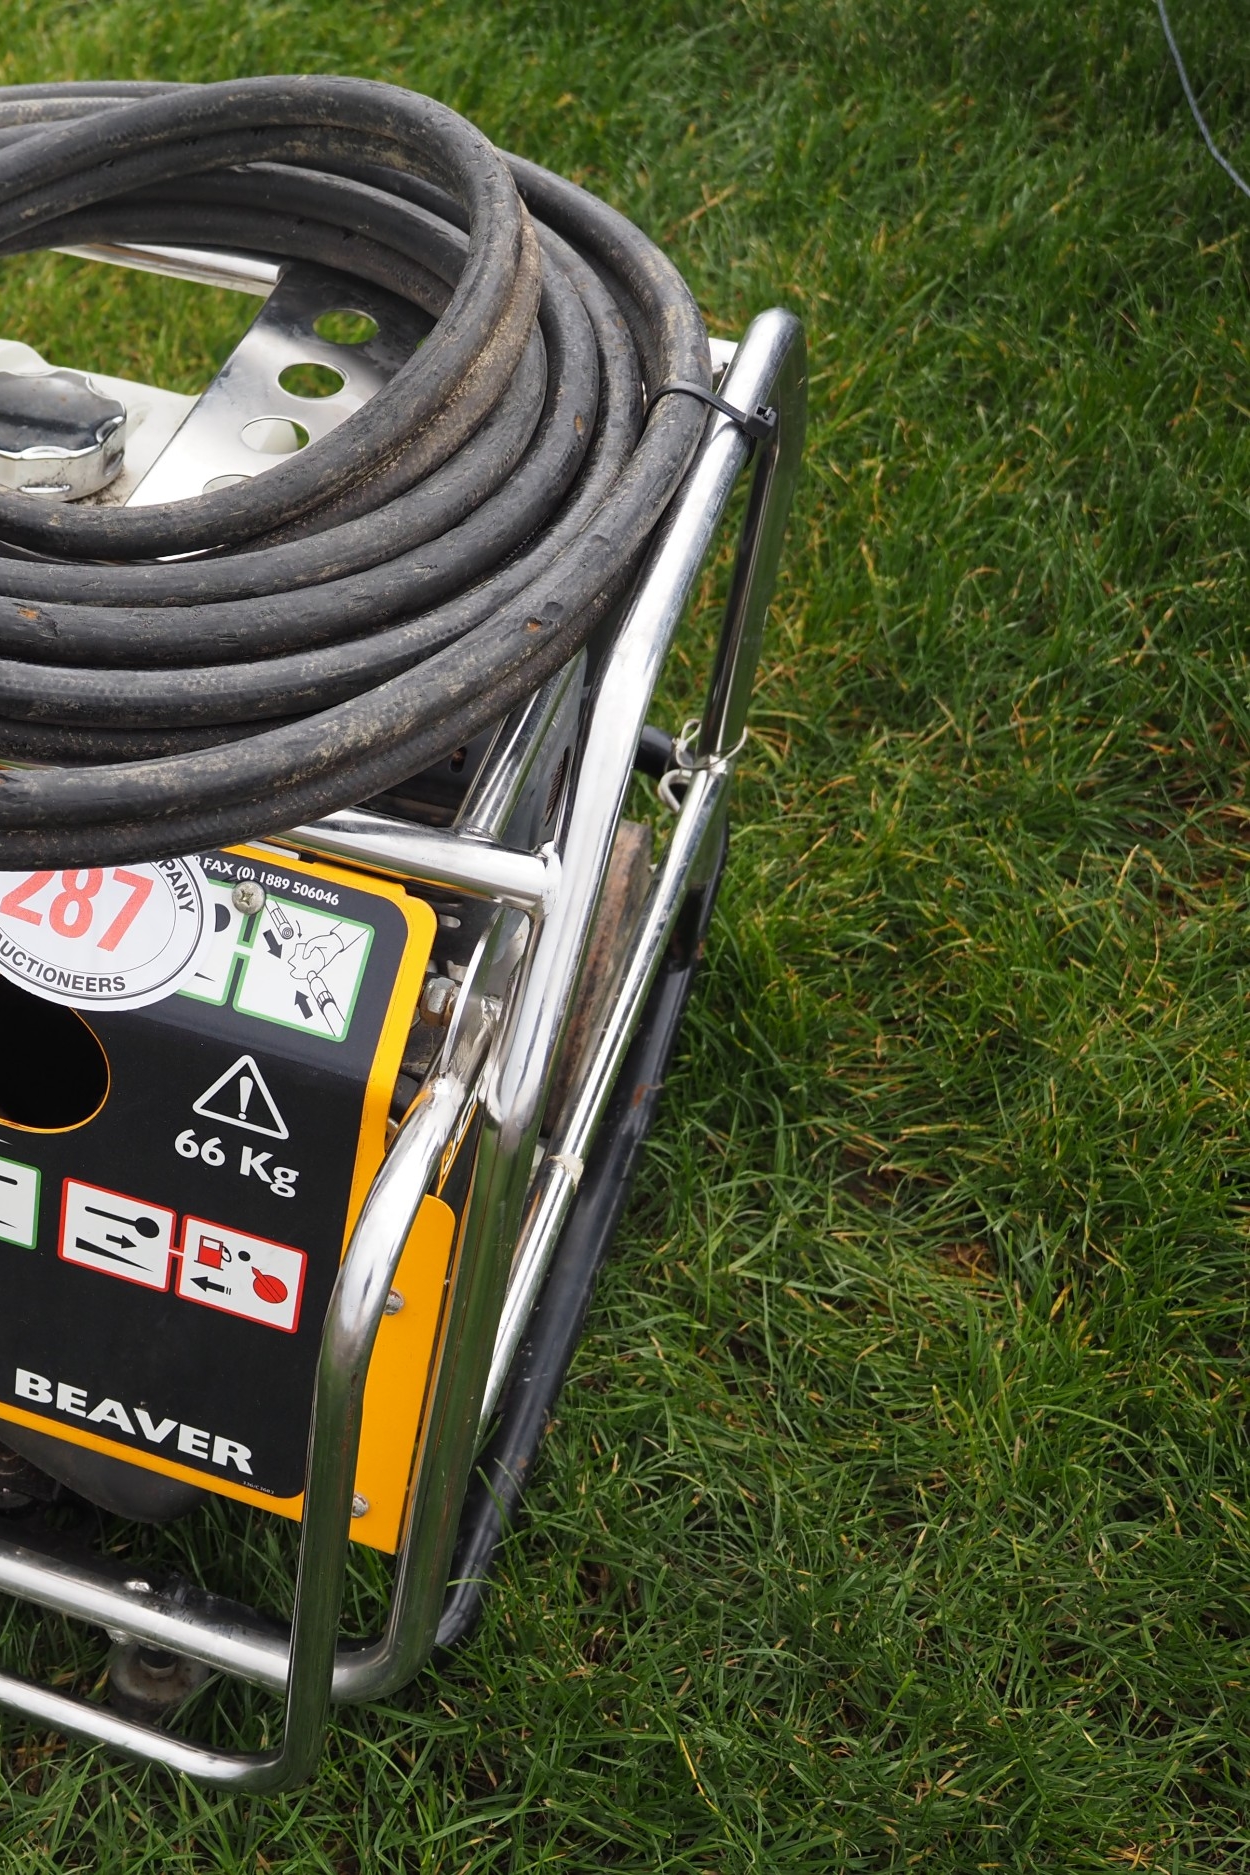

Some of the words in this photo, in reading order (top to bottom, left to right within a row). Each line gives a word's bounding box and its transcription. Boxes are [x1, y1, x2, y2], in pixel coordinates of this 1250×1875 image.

[153, 857, 196, 914] PANY
[203, 857, 234, 875] FAX
[236, 866, 255, 881] (0)
[259, 871, 291, 889] 1889
[291, 882, 340, 906] 506046
[175, 1129, 226, 1167] 66
[240, 1145, 300, 1198] Kg
[15, 1368, 253, 1476] BEAVER
